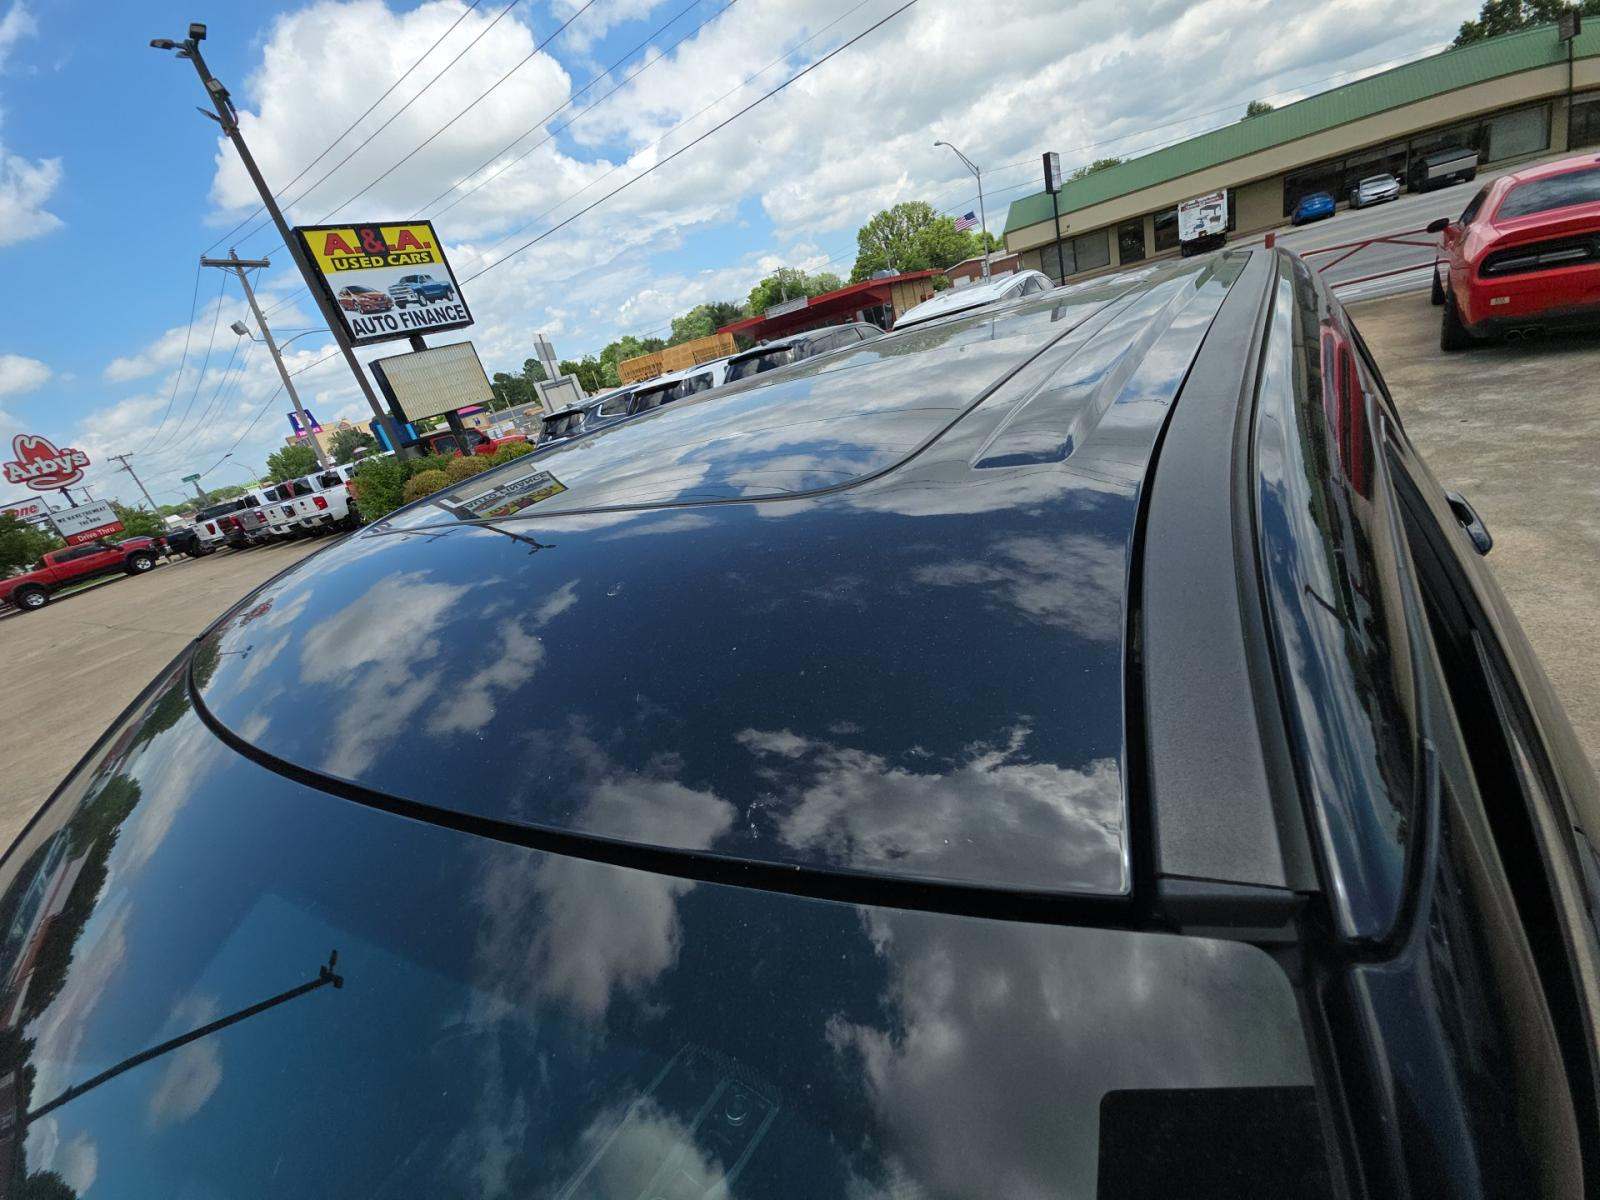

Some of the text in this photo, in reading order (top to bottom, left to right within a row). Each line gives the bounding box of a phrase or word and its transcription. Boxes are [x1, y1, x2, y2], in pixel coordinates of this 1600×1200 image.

[335, 253, 430, 270] USED CARS
[353, 304, 466, 336] AUTO FINANCE
[6, 449, 89, 482] Arby's
[77, 526, 115, 541] Drive Thru
